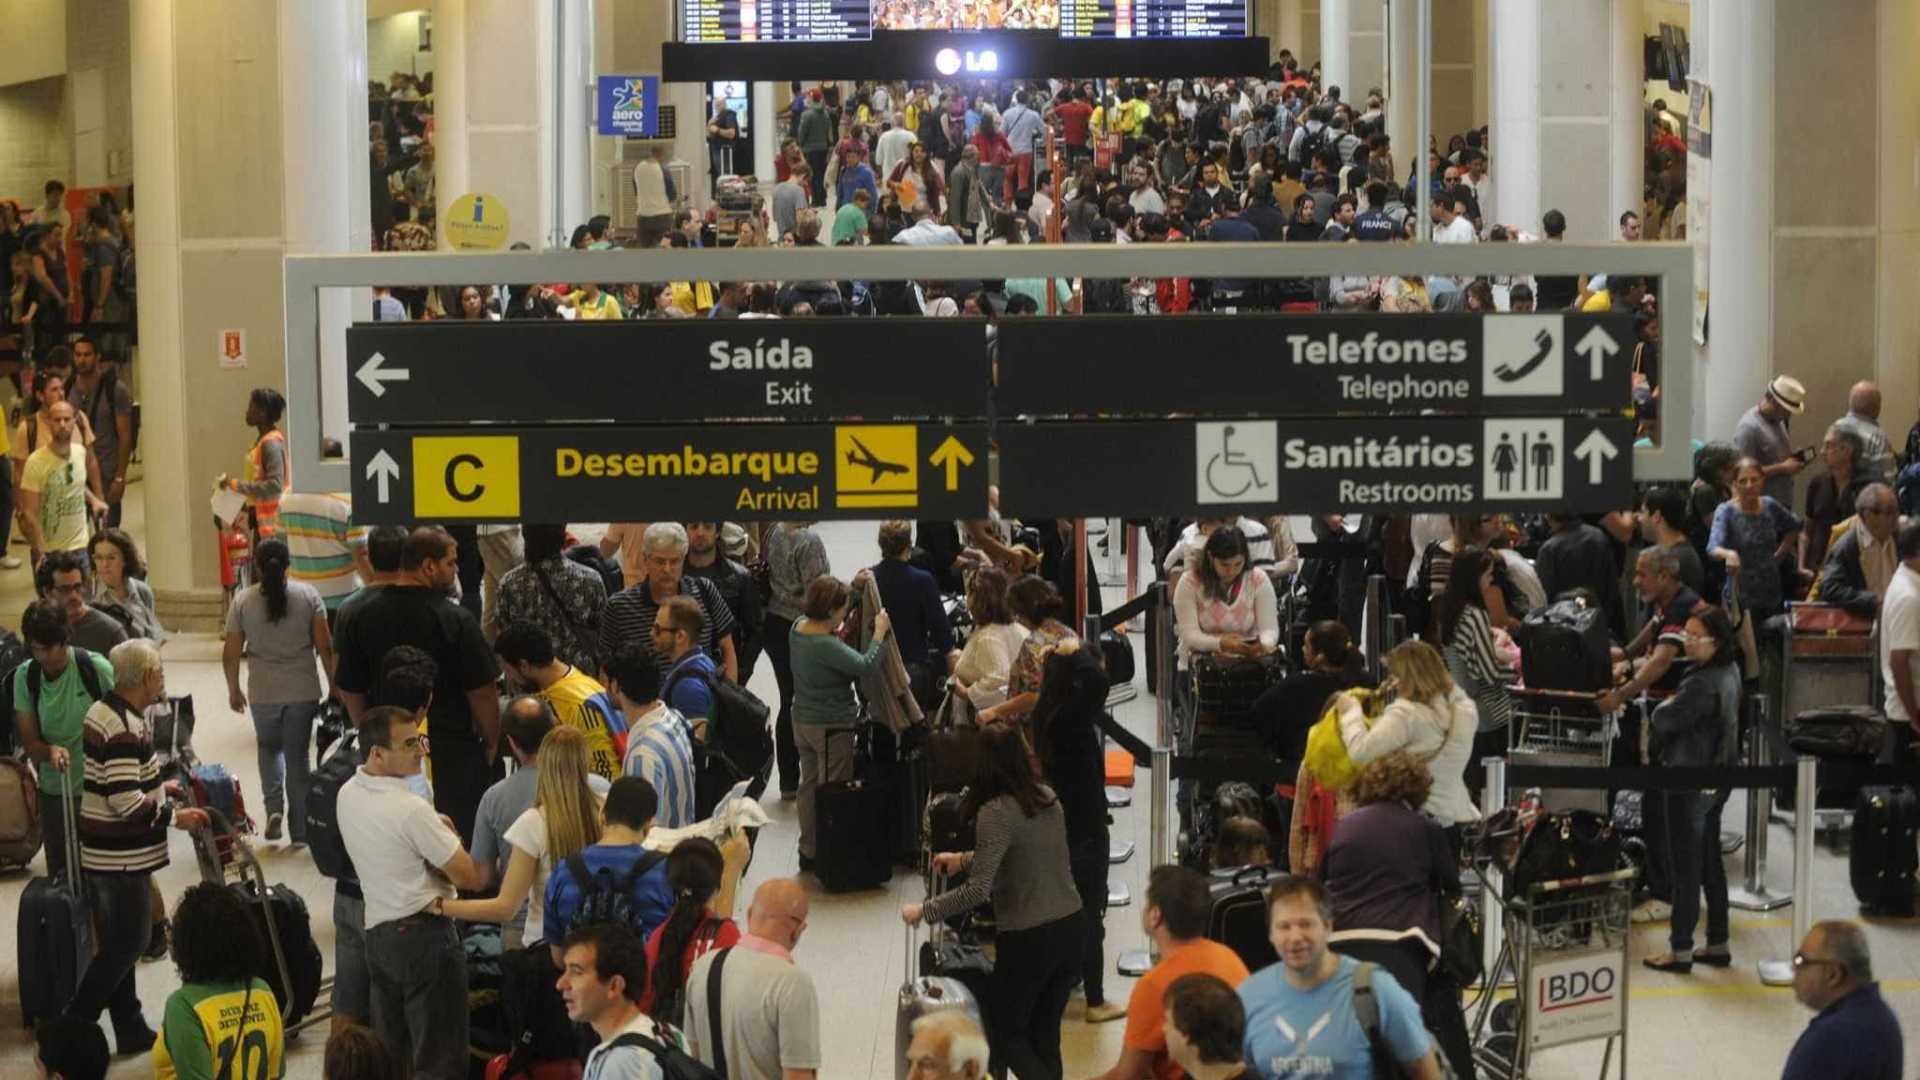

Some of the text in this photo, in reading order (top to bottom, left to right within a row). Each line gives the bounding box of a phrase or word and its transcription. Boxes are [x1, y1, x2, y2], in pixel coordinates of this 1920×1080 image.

[966, 50, 998, 72] LG
[612, 110, 643, 120] aero
[709, 339, 813, 369] Saída
[1287, 333, 1467, 364] Telefones
[766, 381, 812, 405] Exit
[1339, 376, 1469, 403] Telephone
[556, 446, 819, 482] Desembarque
[1284, 437, 1474, 469] Sanitários
[445, 454, 485, 502] C
[1339, 480, 1473, 503] Restrooms
[736, 486, 818, 509] Arrival
[1549, 966, 1615, 1002] BDO
